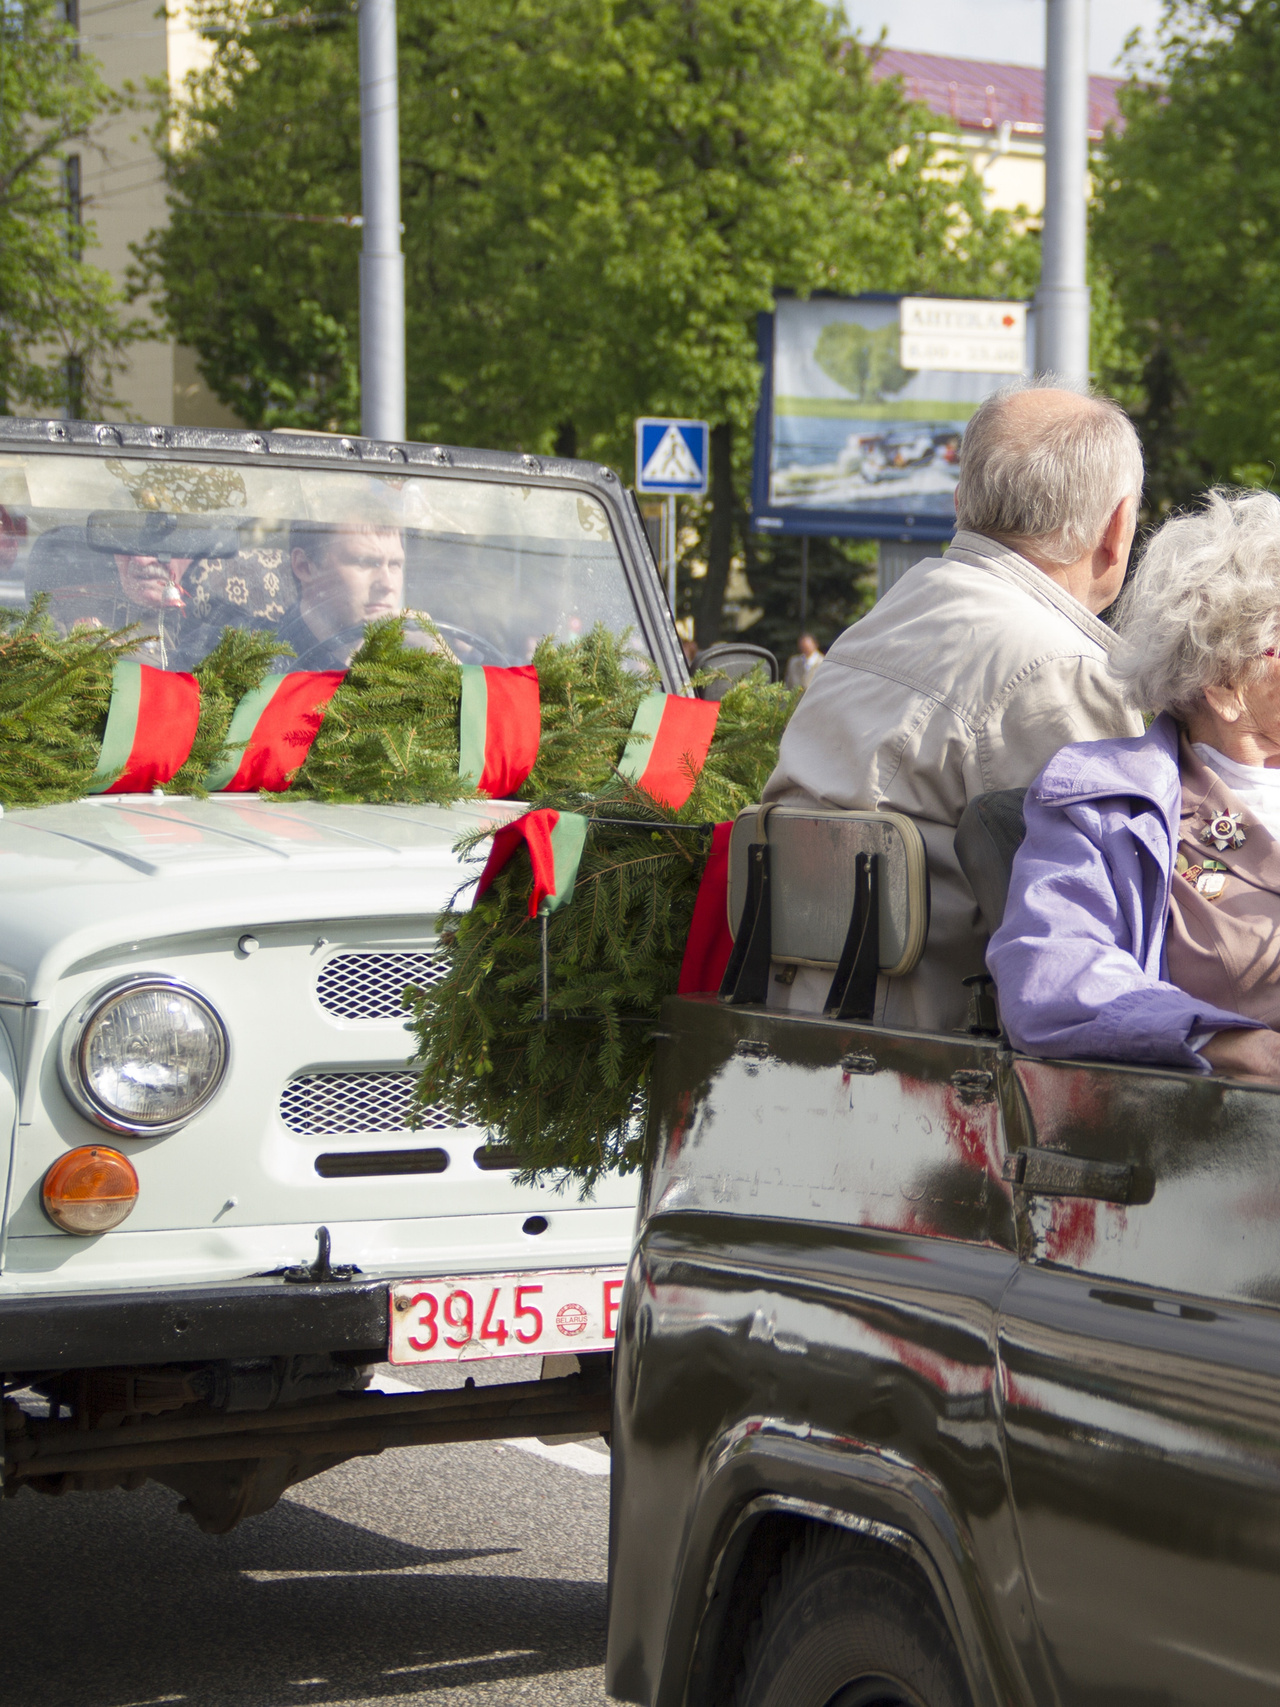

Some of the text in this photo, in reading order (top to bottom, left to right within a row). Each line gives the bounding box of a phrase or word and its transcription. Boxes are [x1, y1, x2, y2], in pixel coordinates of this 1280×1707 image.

[912, 308, 1000, 330] АПТЕКА
[407, 1284, 544, 1352] 3945
[555, 1315, 589, 1325] BELARUS
